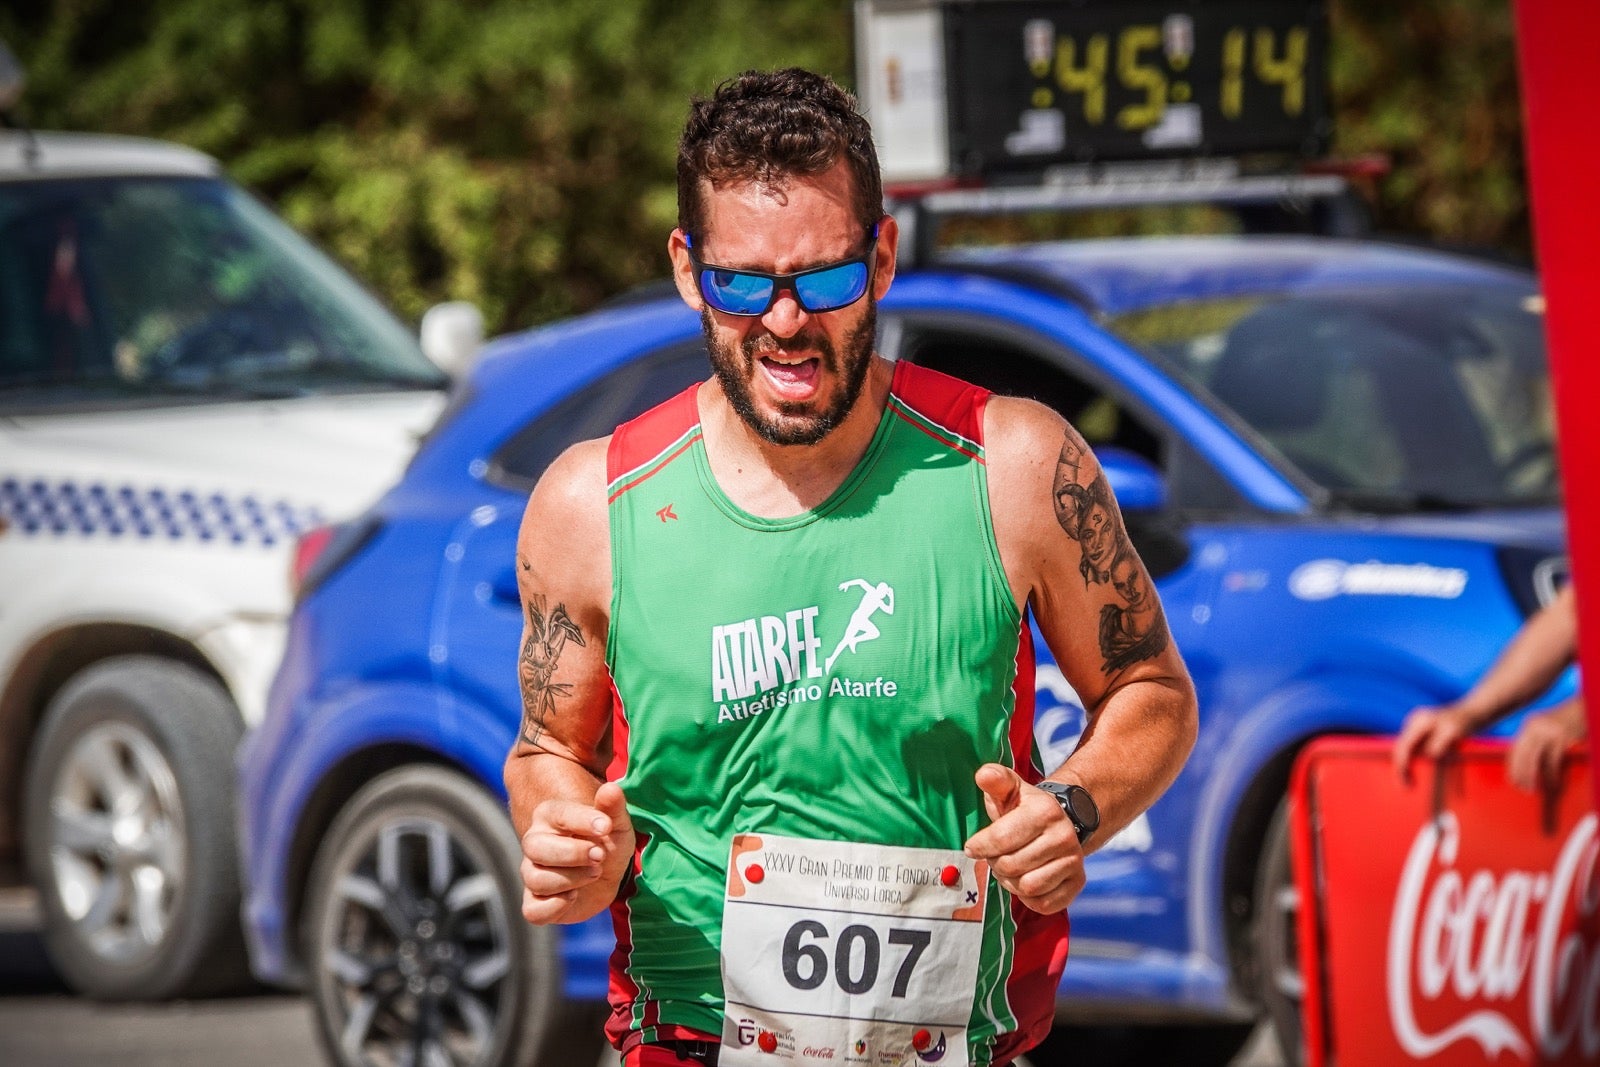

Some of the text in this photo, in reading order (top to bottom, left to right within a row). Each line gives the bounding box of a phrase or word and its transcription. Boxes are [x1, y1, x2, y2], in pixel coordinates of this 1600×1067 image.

[712, 606, 823, 703] ATARFE
[717, 676, 898, 724] Atletismo Atarfe
[764, 852, 796, 874] XXXV
[878, 866, 892, 882] DE
[781, 919, 932, 999] 607
